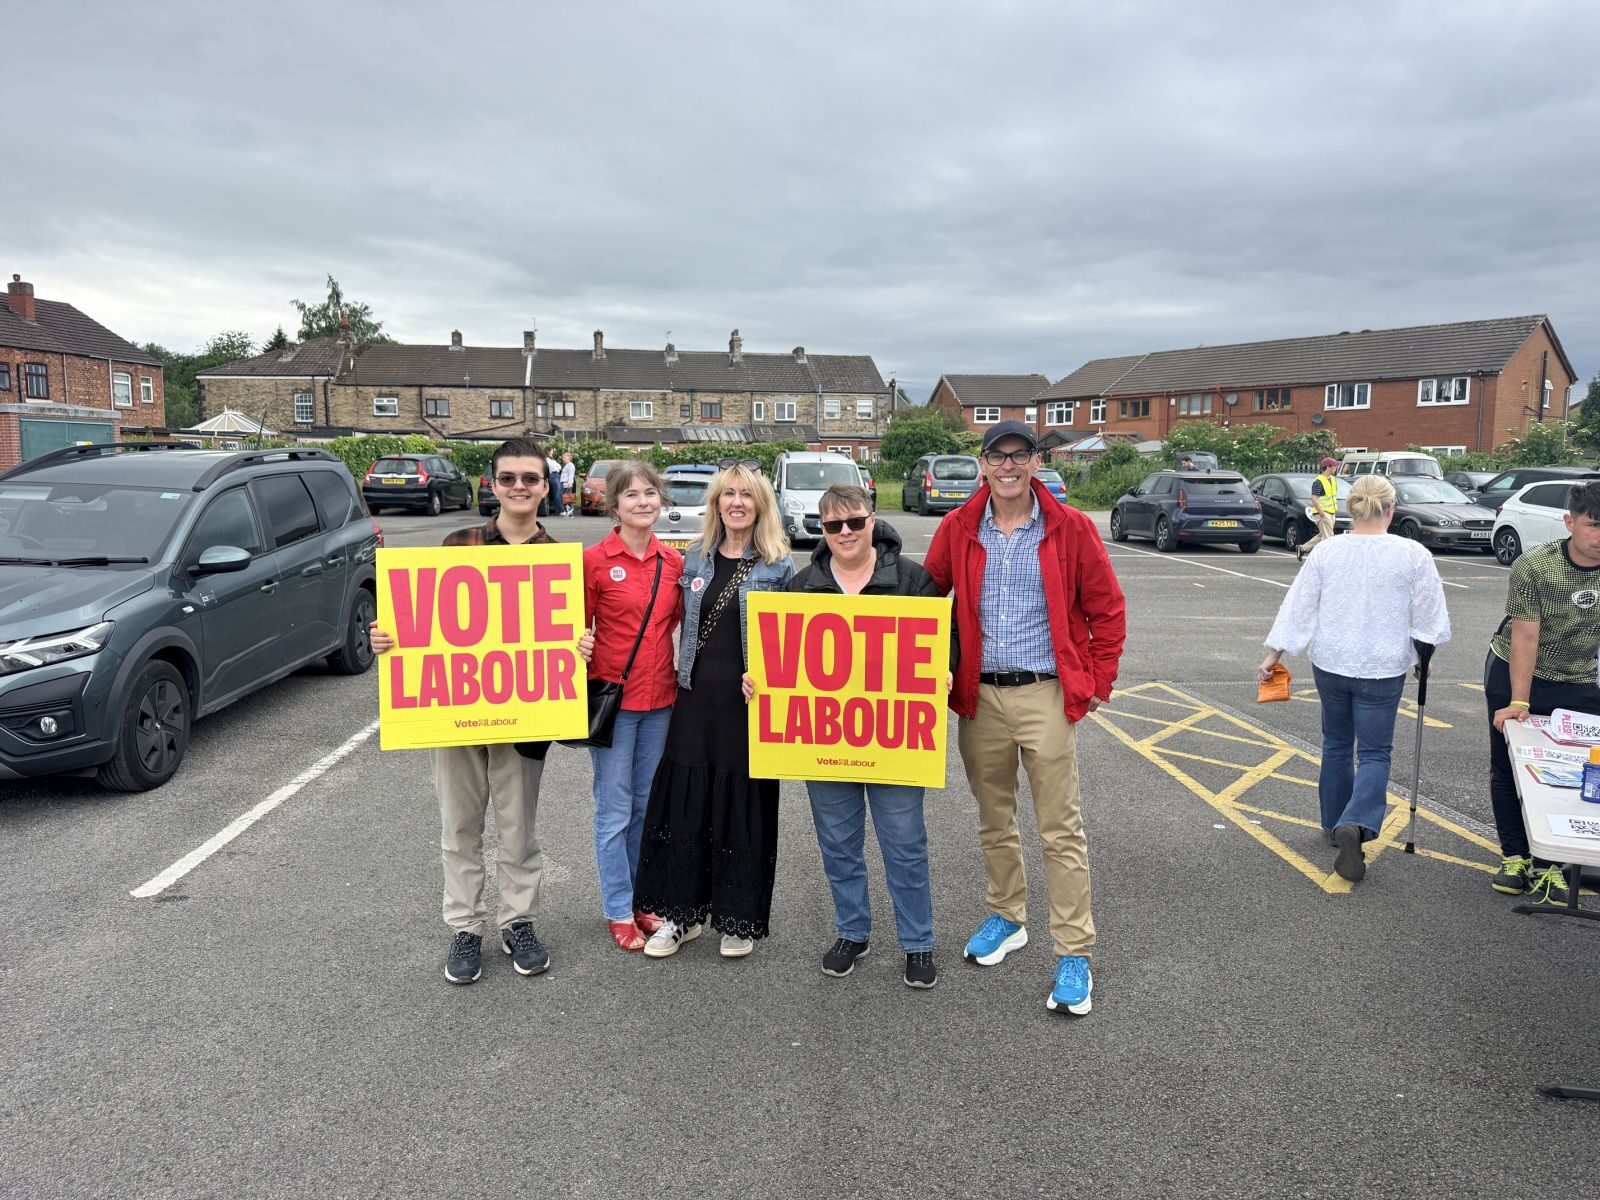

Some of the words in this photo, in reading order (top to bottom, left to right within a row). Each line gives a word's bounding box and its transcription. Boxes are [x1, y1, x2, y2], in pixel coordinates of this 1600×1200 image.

[389, 564, 573, 648] VOTE
[391, 649, 577, 708] LABOUR
[758, 612, 938, 694] VOTE
[454, 719, 479, 728] Vote
[486, 718, 518, 727] Labour
[759, 694, 936, 750] LABOUR
[816, 757, 839, 766] Vote
[846, 759, 877, 768] Labour
